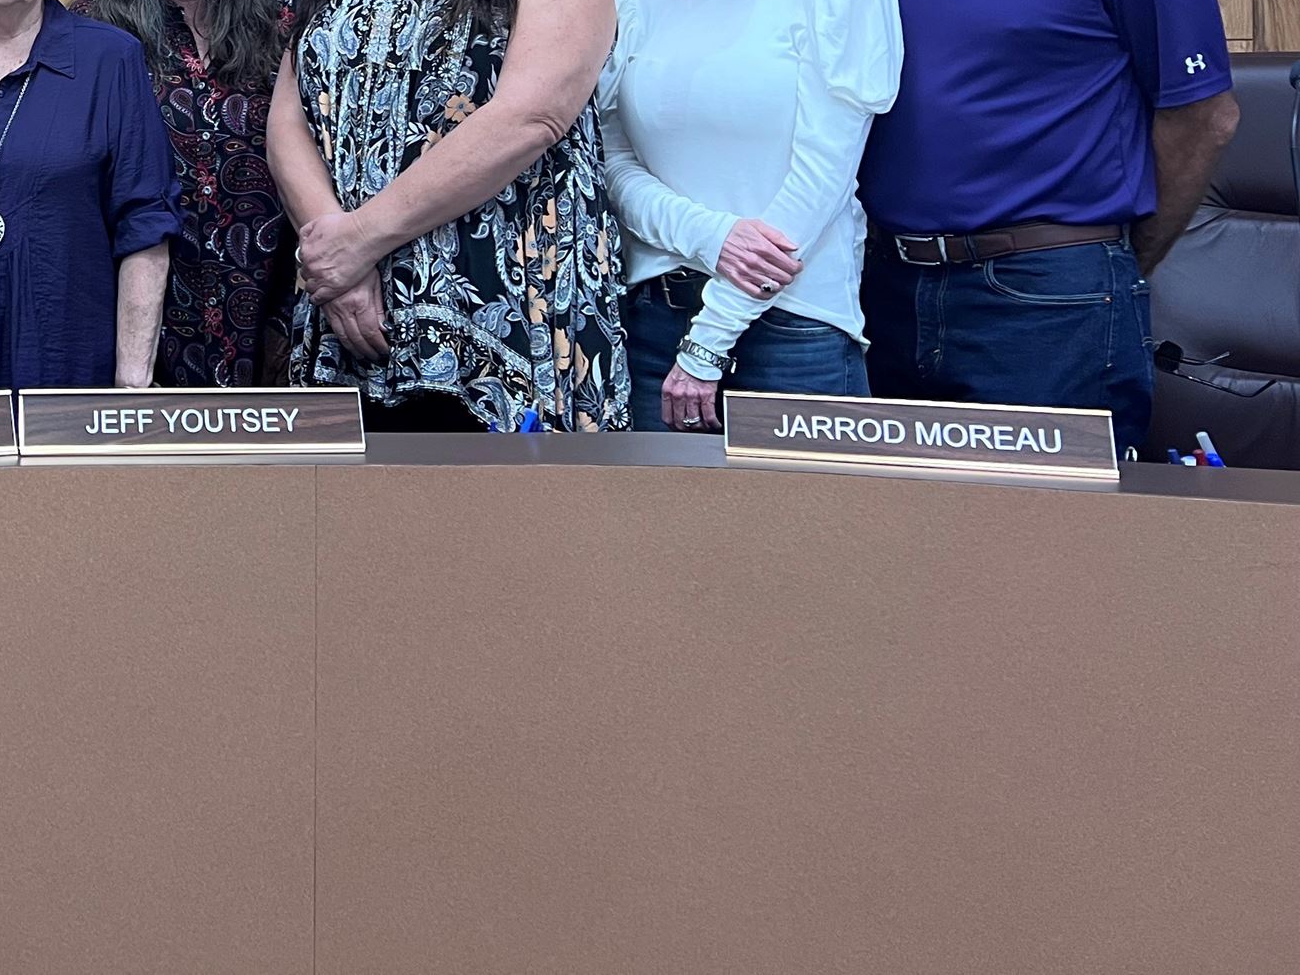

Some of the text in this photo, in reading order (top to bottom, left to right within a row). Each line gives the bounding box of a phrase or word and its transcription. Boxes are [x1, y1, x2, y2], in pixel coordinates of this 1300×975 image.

[85, 407, 300, 436] JEFF YOUTSEY
[773, 414, 1063, 455] JARROD MOREAU
